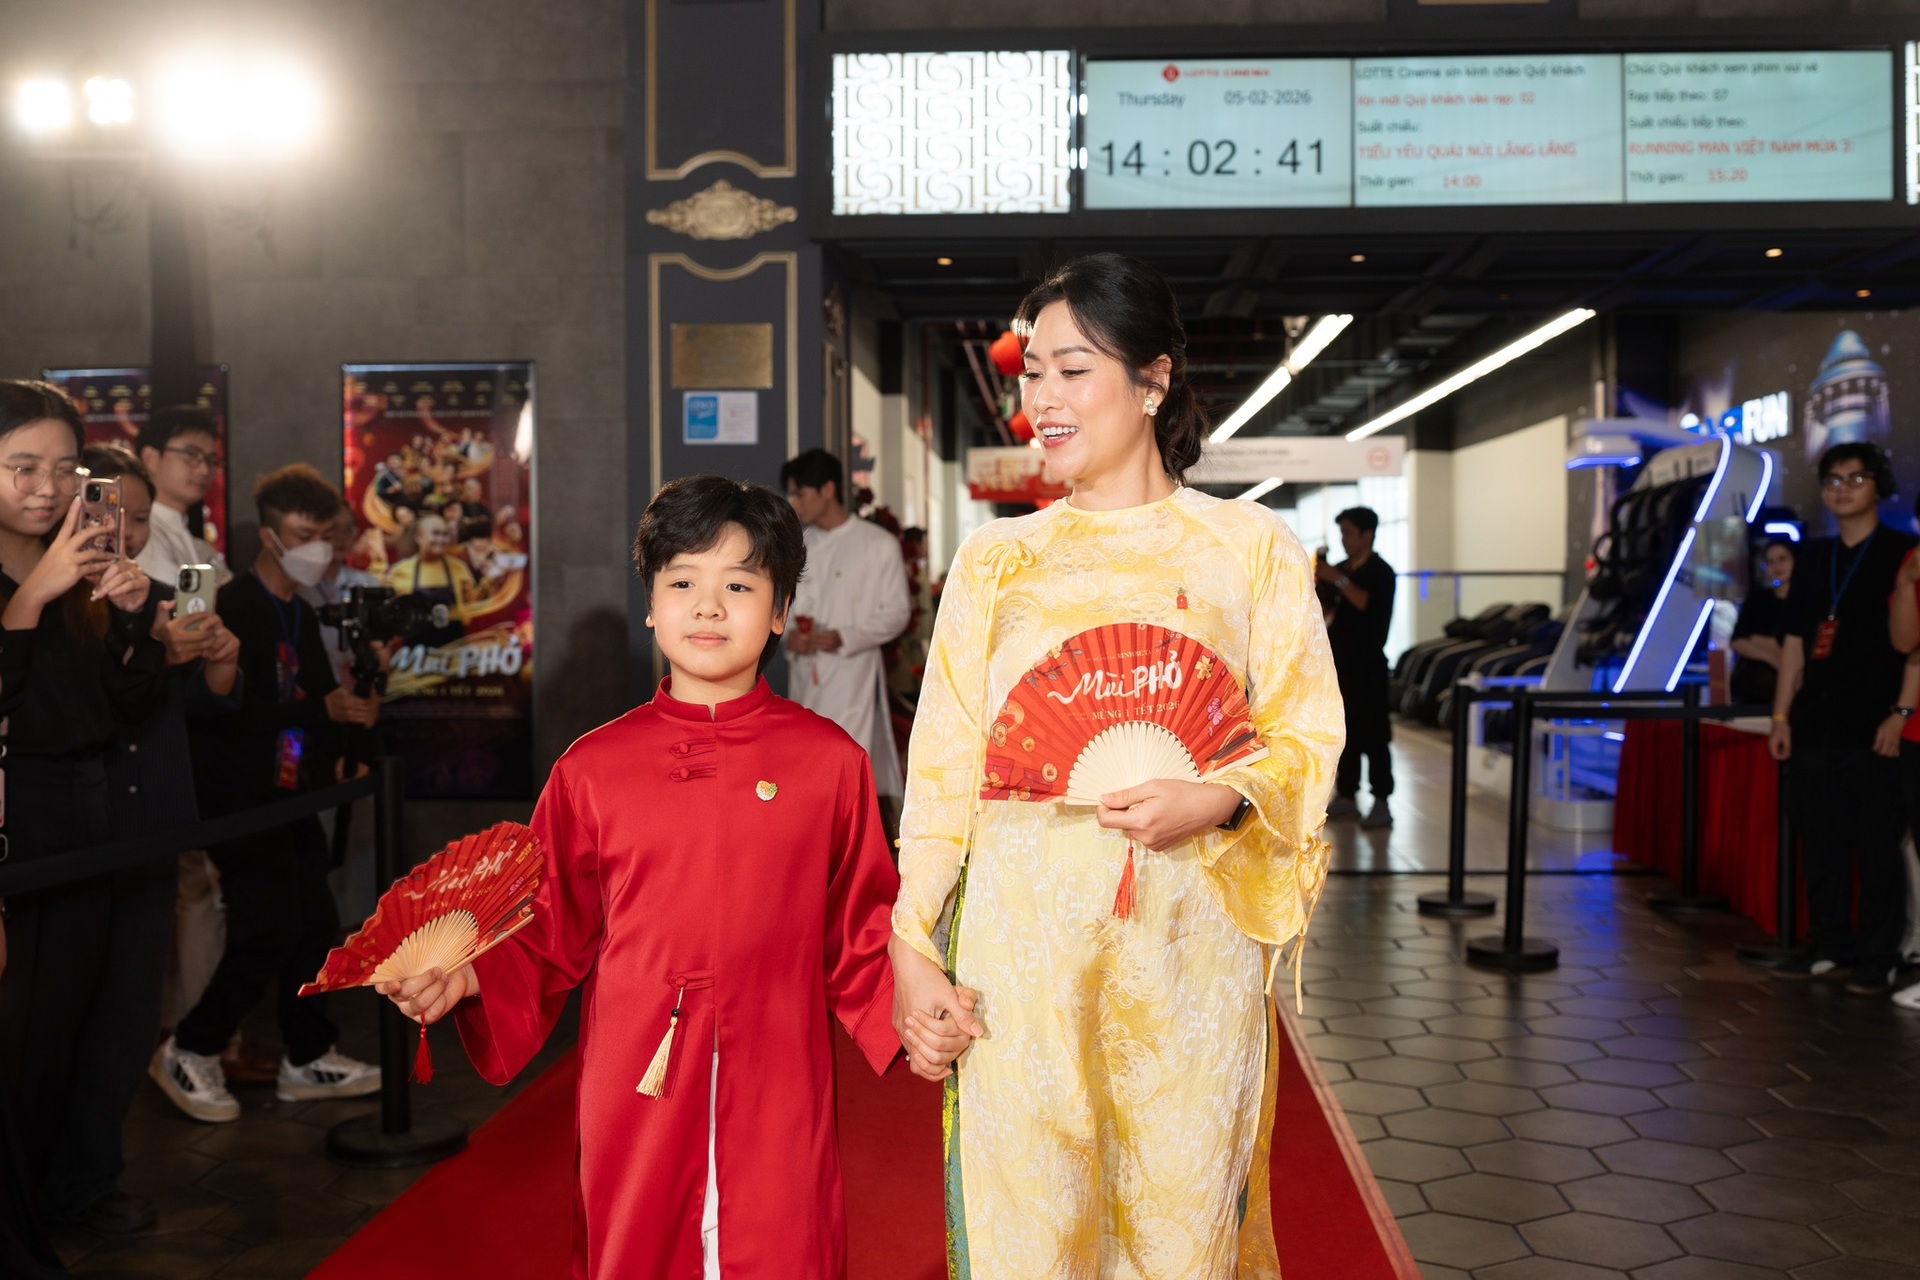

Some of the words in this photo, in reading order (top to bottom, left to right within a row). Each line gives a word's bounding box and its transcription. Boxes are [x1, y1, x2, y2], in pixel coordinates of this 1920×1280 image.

[1356, 65, 1395, 79] LOTTE
[1398, 65, 1441, 78] Cinema
[1117, 91, 1186, 108] Thursday
[1224, 89, 1312, 106] 05-02-2026
[1100, 140, 1146, 176] 14
[1187, 139, 1238, 176] 02
[1277, 138, 1323, 175] 41
[1629, 141, 1694, 155] RUNNING
[1047, 669, 1135, 705] Mùi
